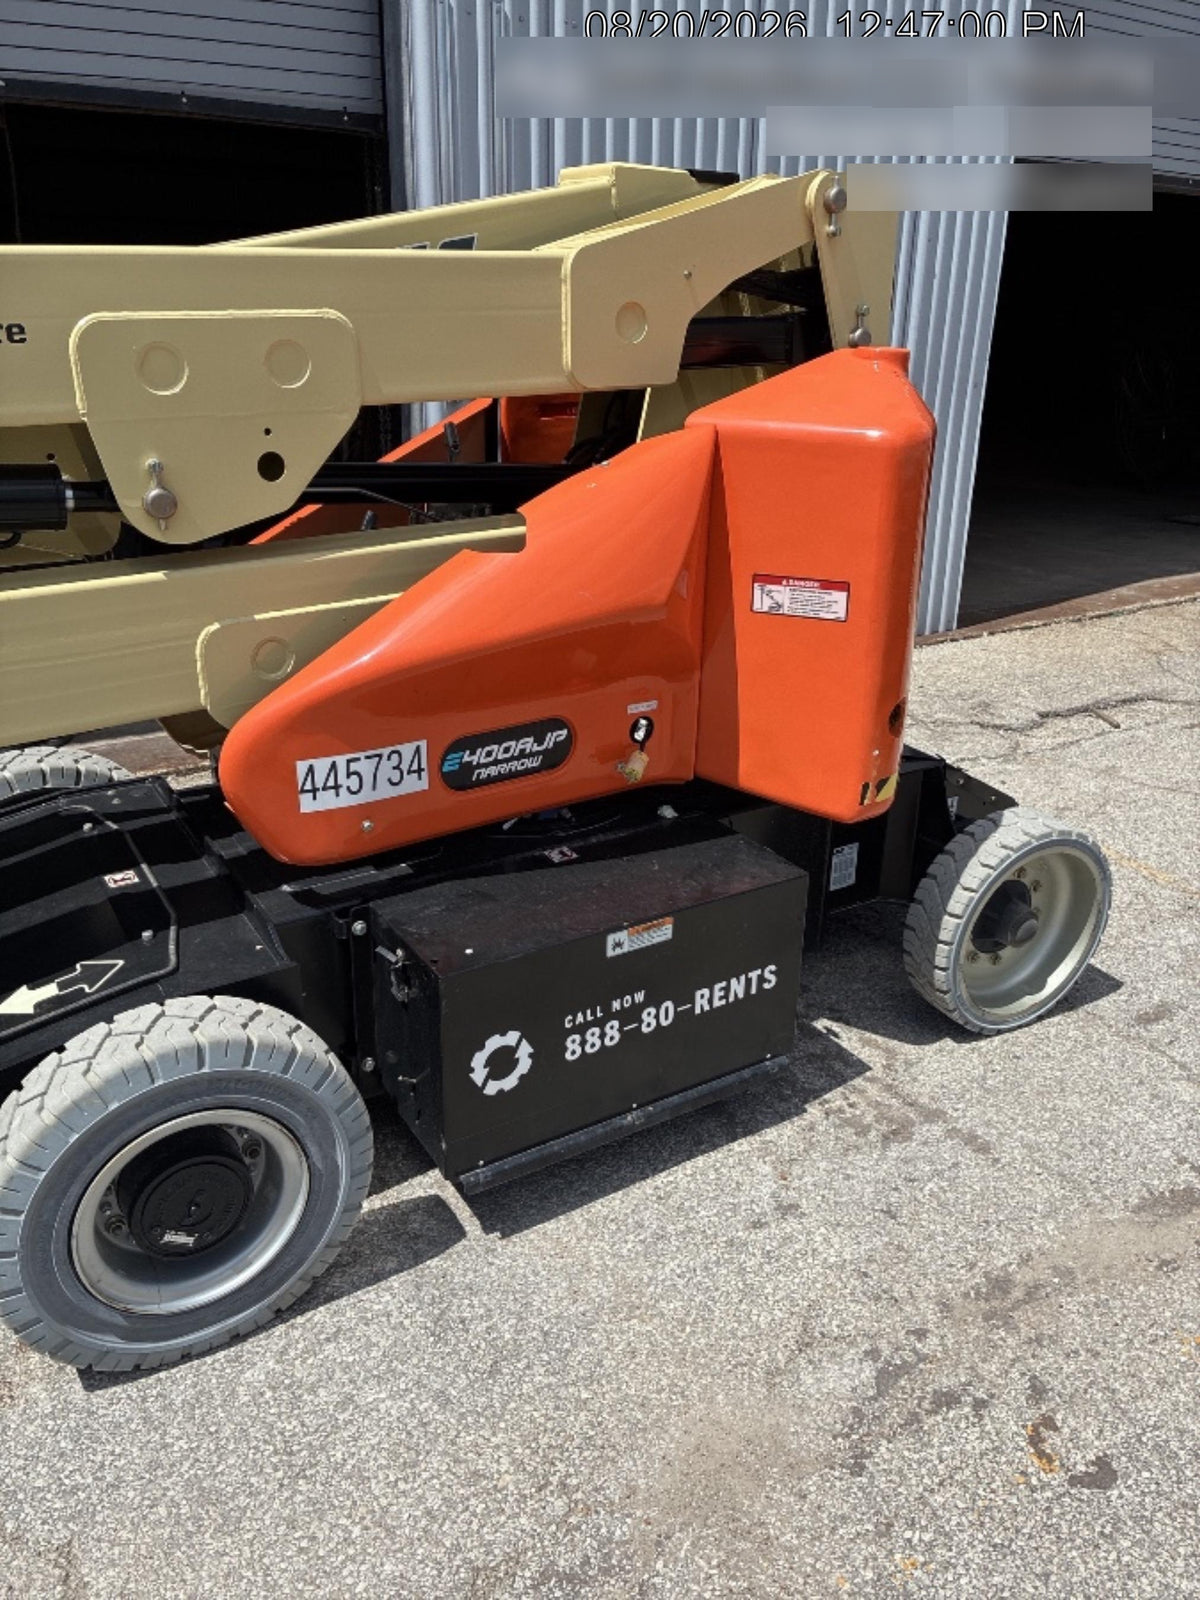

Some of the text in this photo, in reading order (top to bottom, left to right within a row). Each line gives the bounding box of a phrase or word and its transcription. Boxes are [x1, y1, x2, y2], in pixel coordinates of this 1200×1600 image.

[299, 744, 425, 801] 445734
[442, 728, 567, 773] E400AJP
[472, 755, 543, 781] NARROW
[564, 990, 646, 1028] CALL NOW
[564, 964, 778, 1061] 888-80-RENTS
